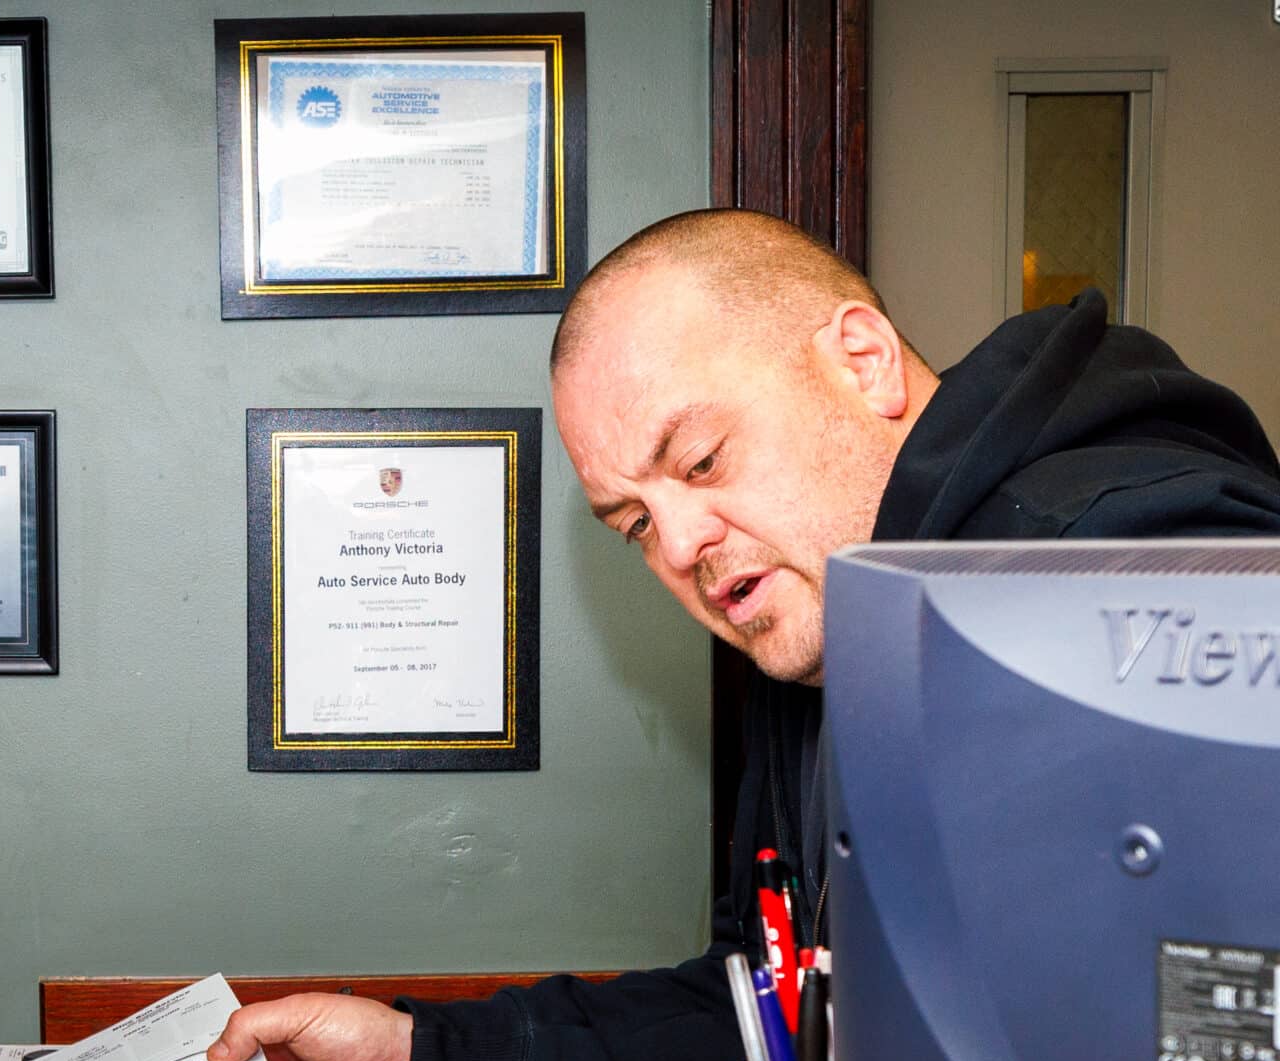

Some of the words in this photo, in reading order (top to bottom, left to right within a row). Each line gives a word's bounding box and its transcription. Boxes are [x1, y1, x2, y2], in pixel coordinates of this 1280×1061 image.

[371, 92, 440, 100] AUTOMOTIVE
[303, 102, 336, 118] ASE
[371, 107, 440, 115] EXCELLENCE
[353, 500, 429, 509] PORSCHE
[349, 530, 384, 541] Training
[387, 528, 435, 540] Certificate
[339, 544, 391, 557] Anthony
[395, 542, 444, 555] Victoria
[317, 576, 346, 588] Auto
[351, 574, 397, 587] Service
[402, 573, 430, 585] Auto
[435, 572, 466, 586] Body
[380, 621, 396, 629] Body
[405, 619, 436, 628] Structural
[438, 619, 459, 628] Repair
[353, 665, 388, 673] September
